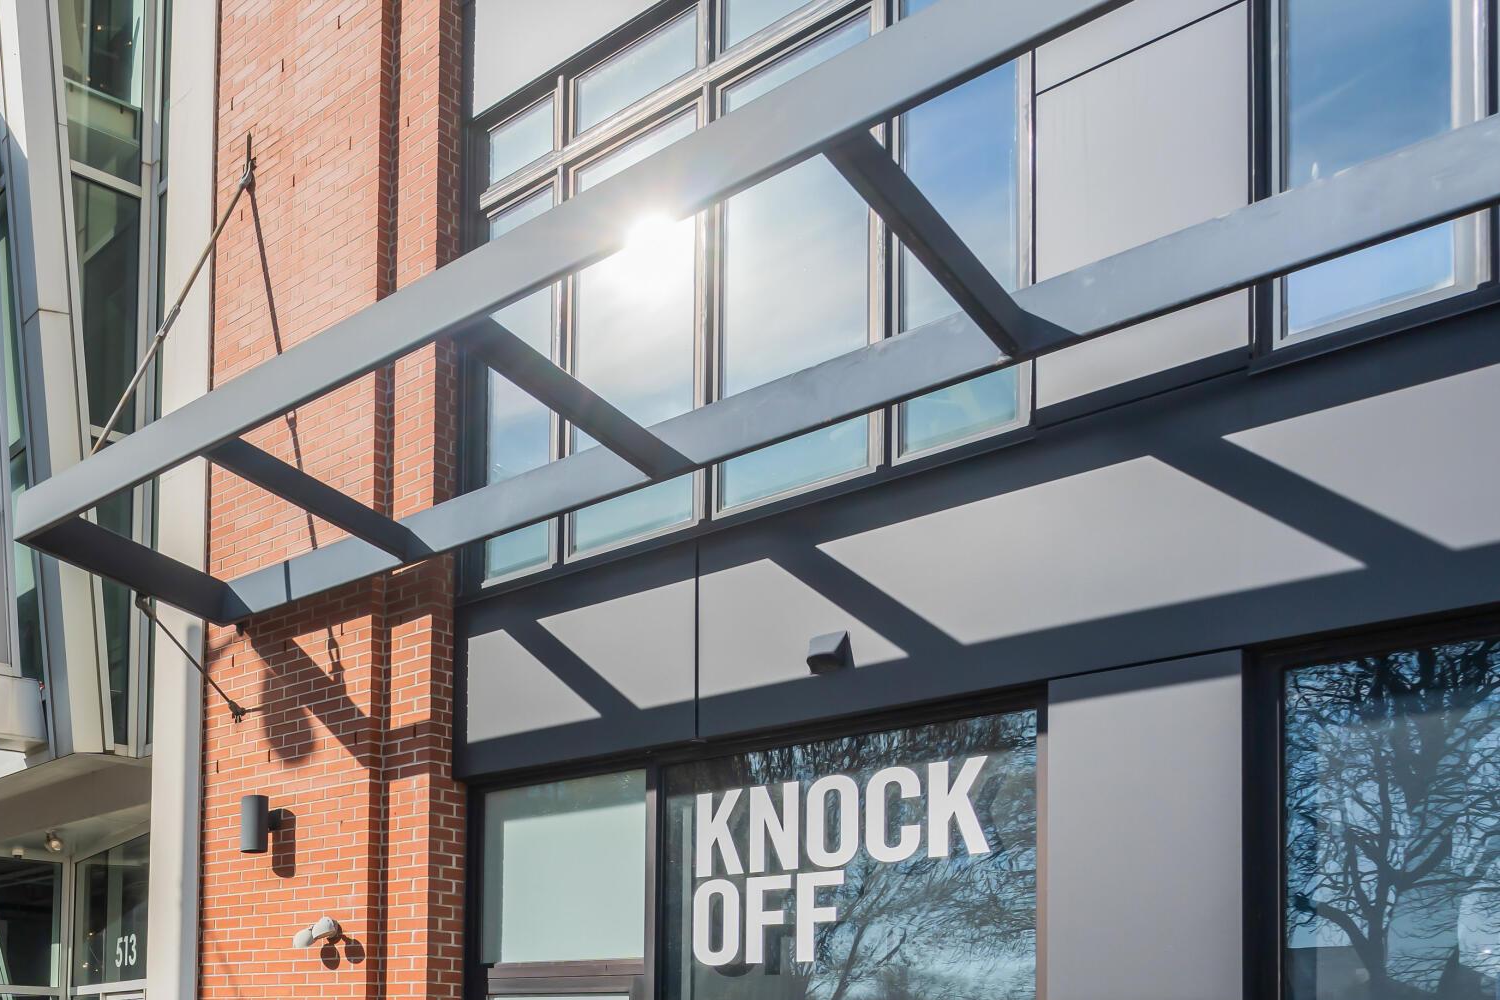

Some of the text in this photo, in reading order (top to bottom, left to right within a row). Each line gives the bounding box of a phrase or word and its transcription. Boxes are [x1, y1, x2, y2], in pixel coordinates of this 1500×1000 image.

[695, 755, 991, 878] KNOCK
[114, 933, 137, 968] 513
[692, 870, 845, 967] OFF
